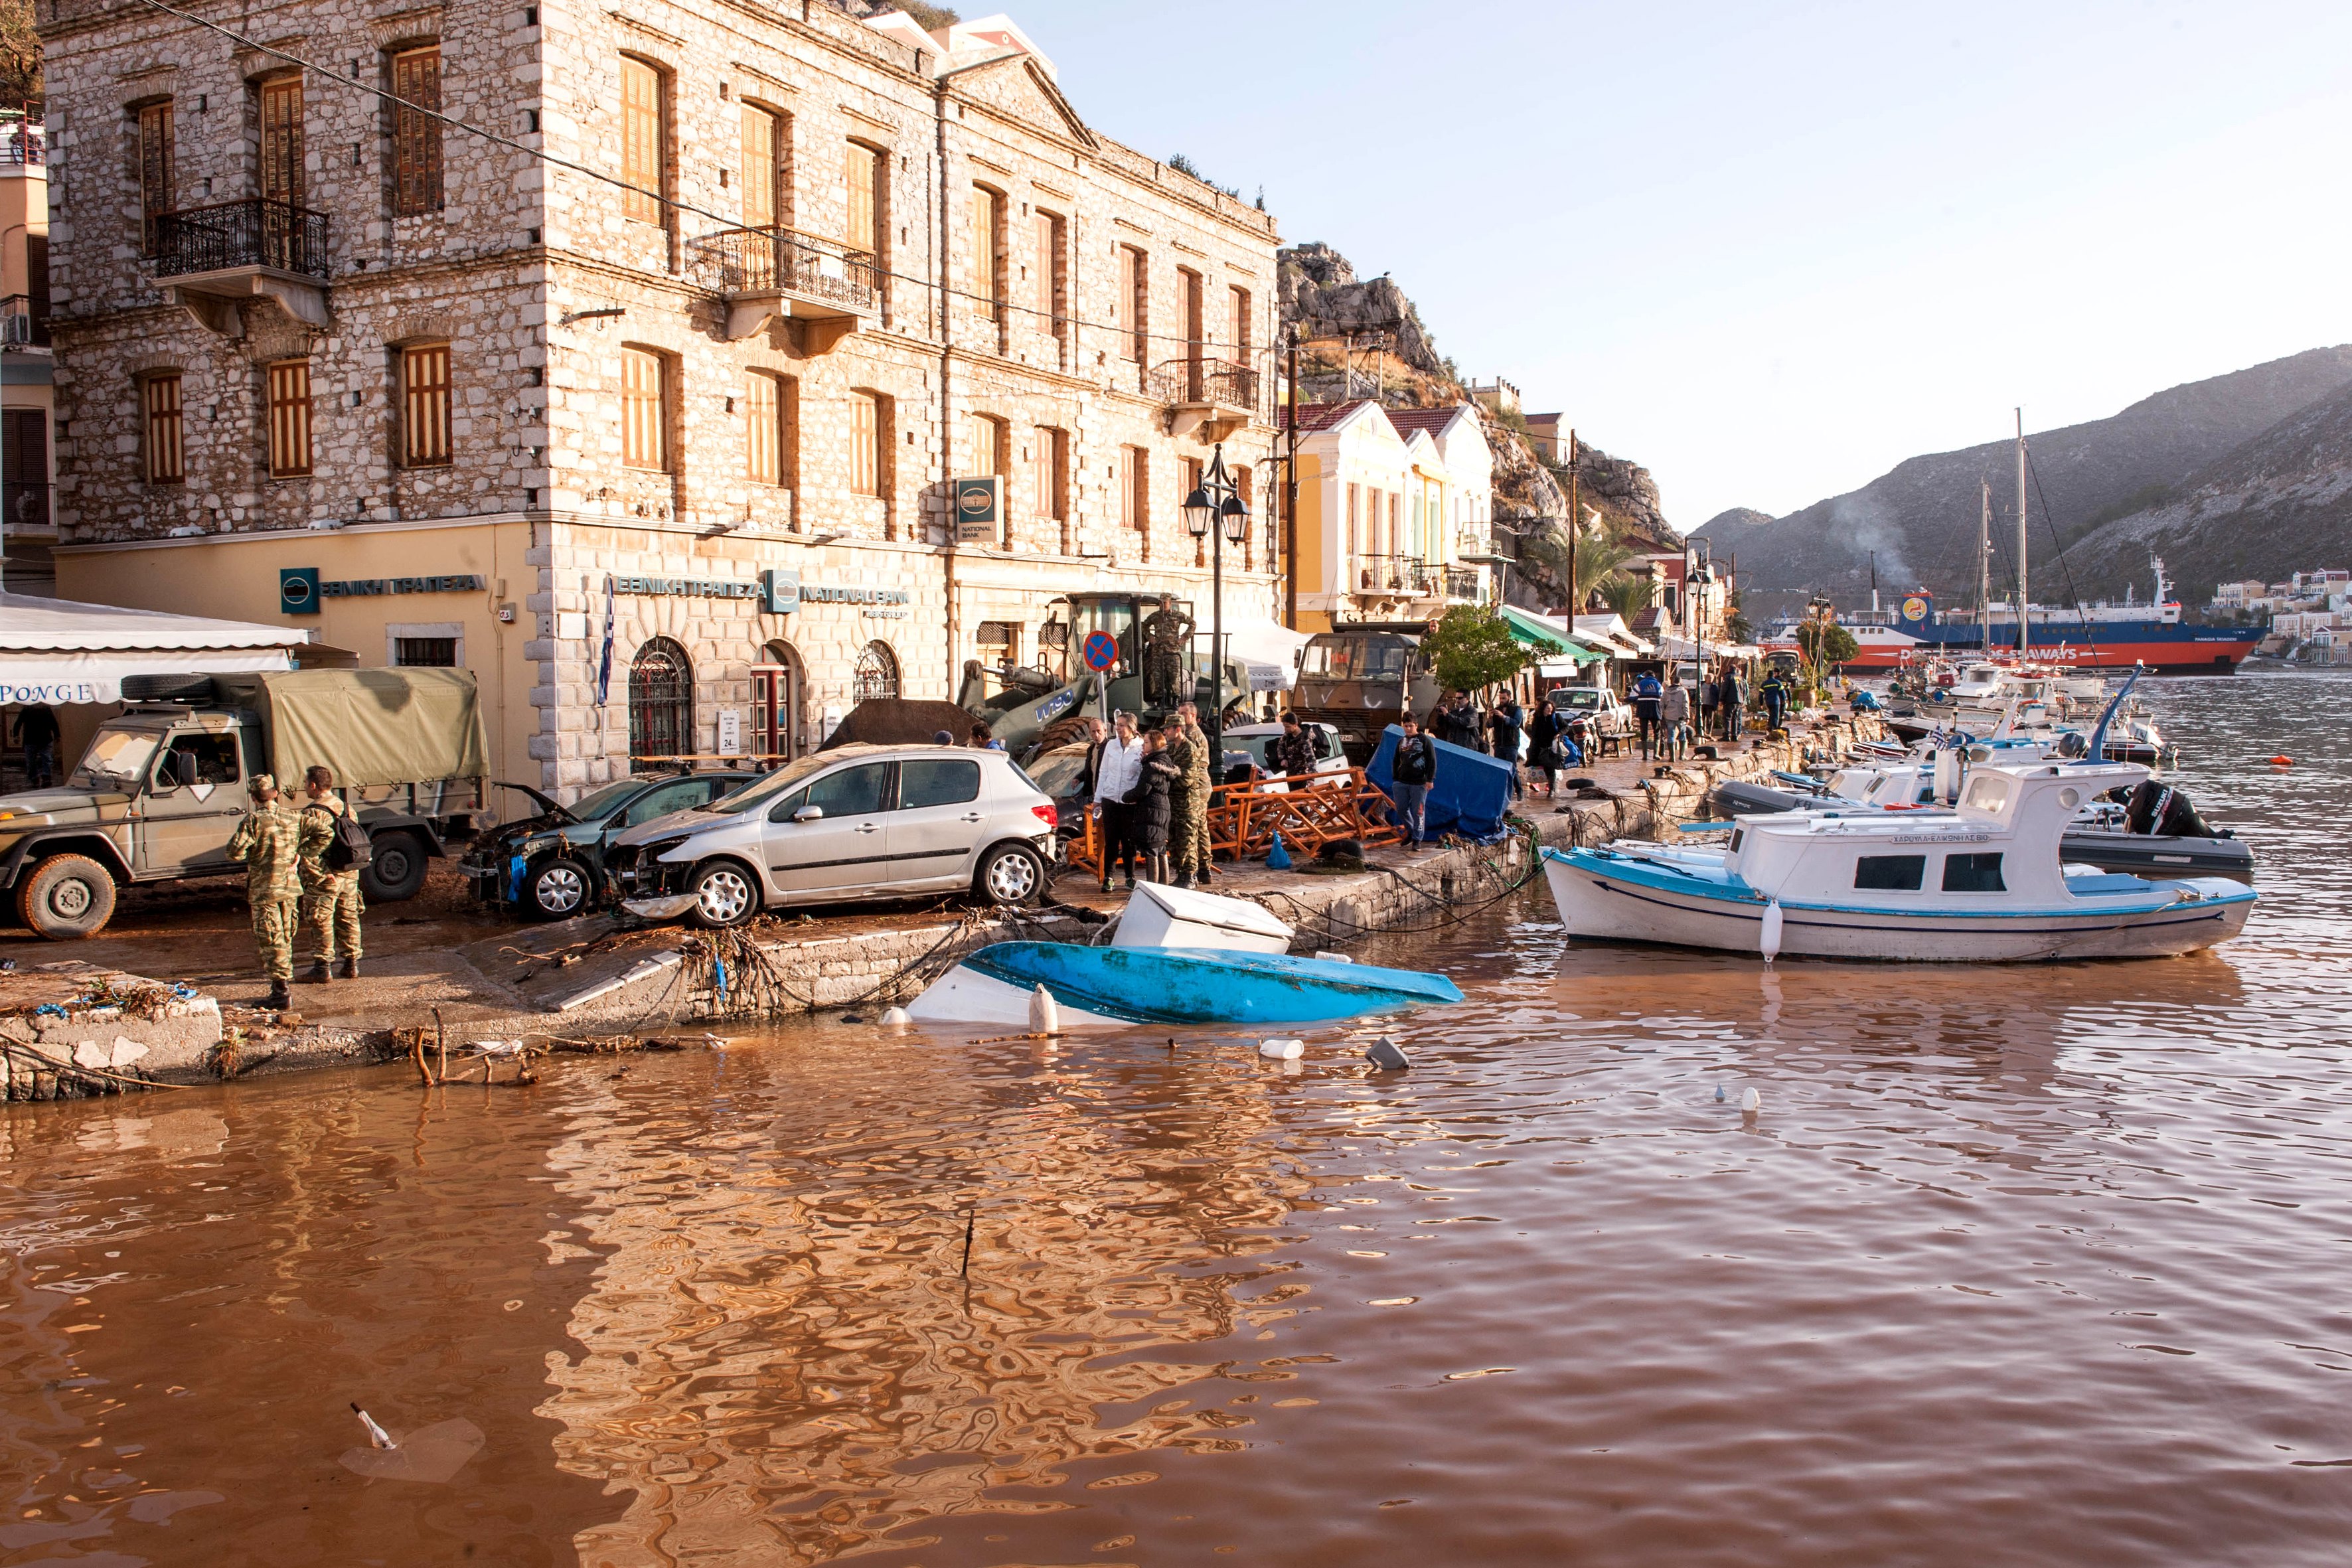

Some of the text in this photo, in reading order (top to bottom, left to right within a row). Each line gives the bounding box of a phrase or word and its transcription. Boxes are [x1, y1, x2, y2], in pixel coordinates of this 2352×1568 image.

[320, 575, 483, 597] ΕΘΝΙΚΗ ΤΡΑΠΕΖΑ
[618, 576, 767, 598] ΕΘΝΙΚΗ ΤΡΑΠΕΖΑ
[803, 587, 910, 604] NATIONAL BANK
[2151, 789, 2169, 818] SUZUKI
